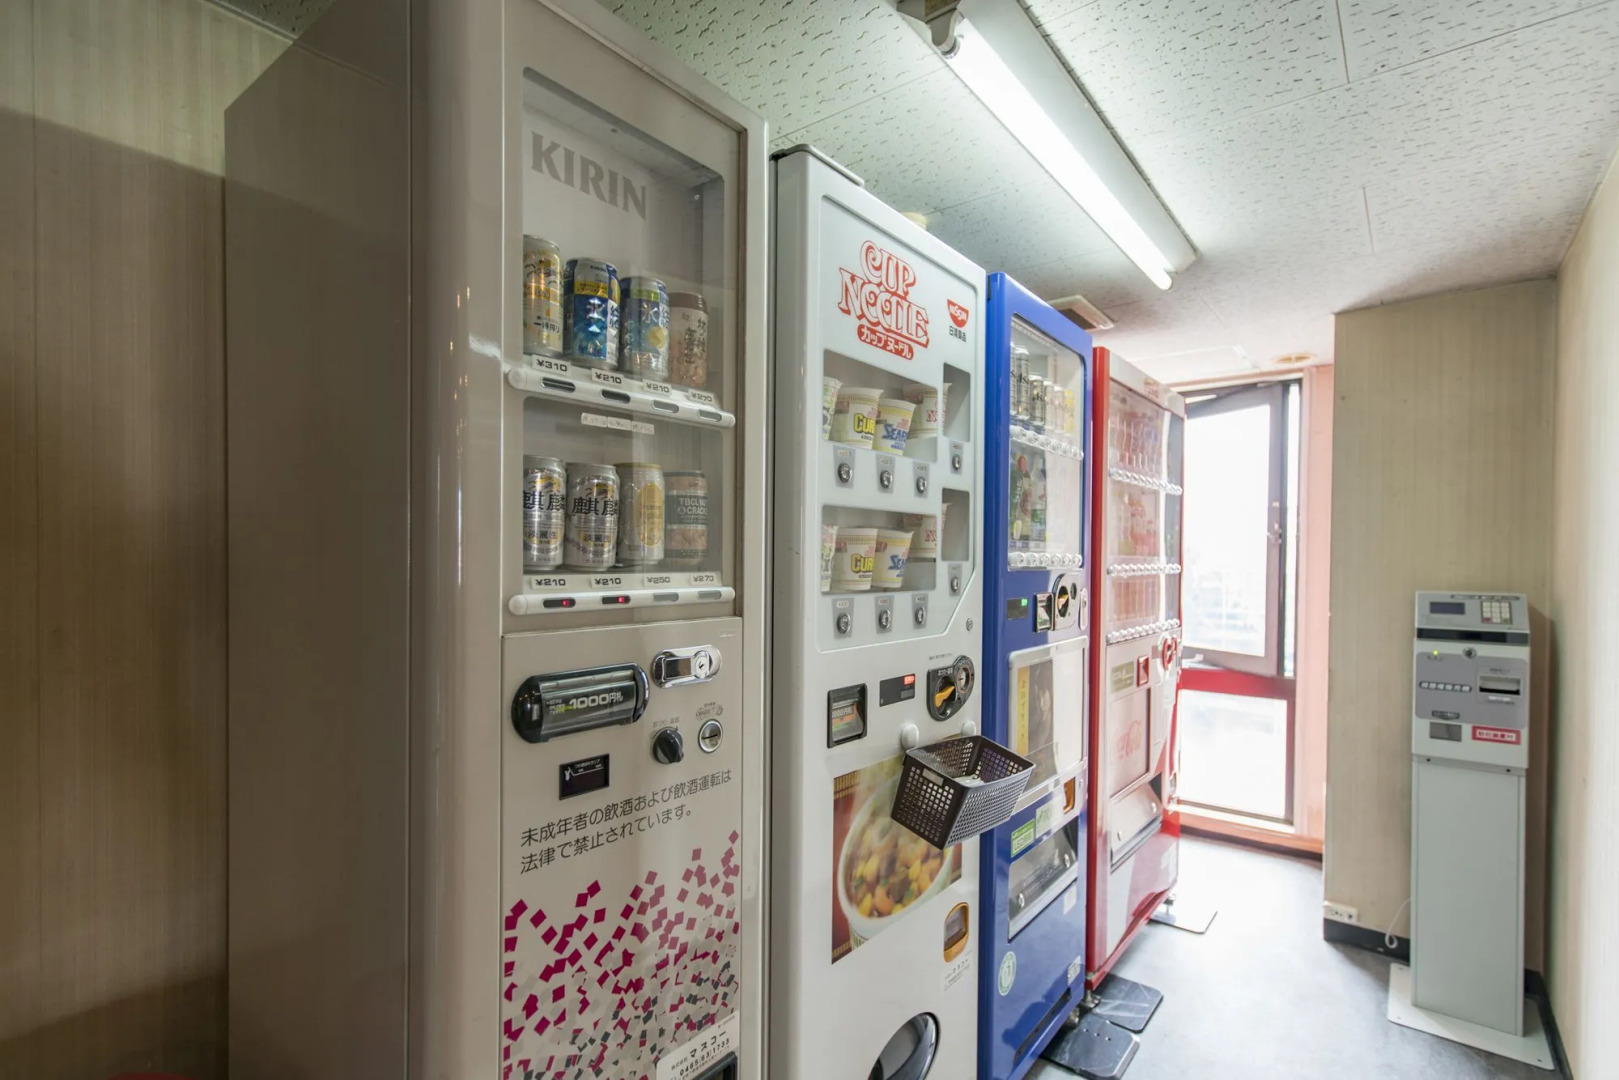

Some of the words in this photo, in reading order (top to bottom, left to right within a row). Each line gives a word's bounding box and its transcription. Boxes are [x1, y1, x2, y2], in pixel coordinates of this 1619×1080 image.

[531, 131, 647, 220] KIRIN
[860, 240, 916, 298] CUP
[838, 266, 930, 349] NOODLE
[860, 325, 912, 360] カップヌードル
[536, 359, 568, 372] ¥310
[595, 372, 622, 384] ¥210
[646, 382, 670, 393] ¥210
[536, 578, 566, 586] ¥210
[595, 577, 622, 586] ¥210
[647, 576, 671, 584] ¥250
[693, 575, 715, 583] ¥270
[569, 690, 624, 710] 1000円札
[521, 769, 732, 848] 未成年者の飲酒および飲酒運転は
[521, 803, 692, 875] 法律で禁止されています。
[690, 1031, 727, 1058] マスコー
